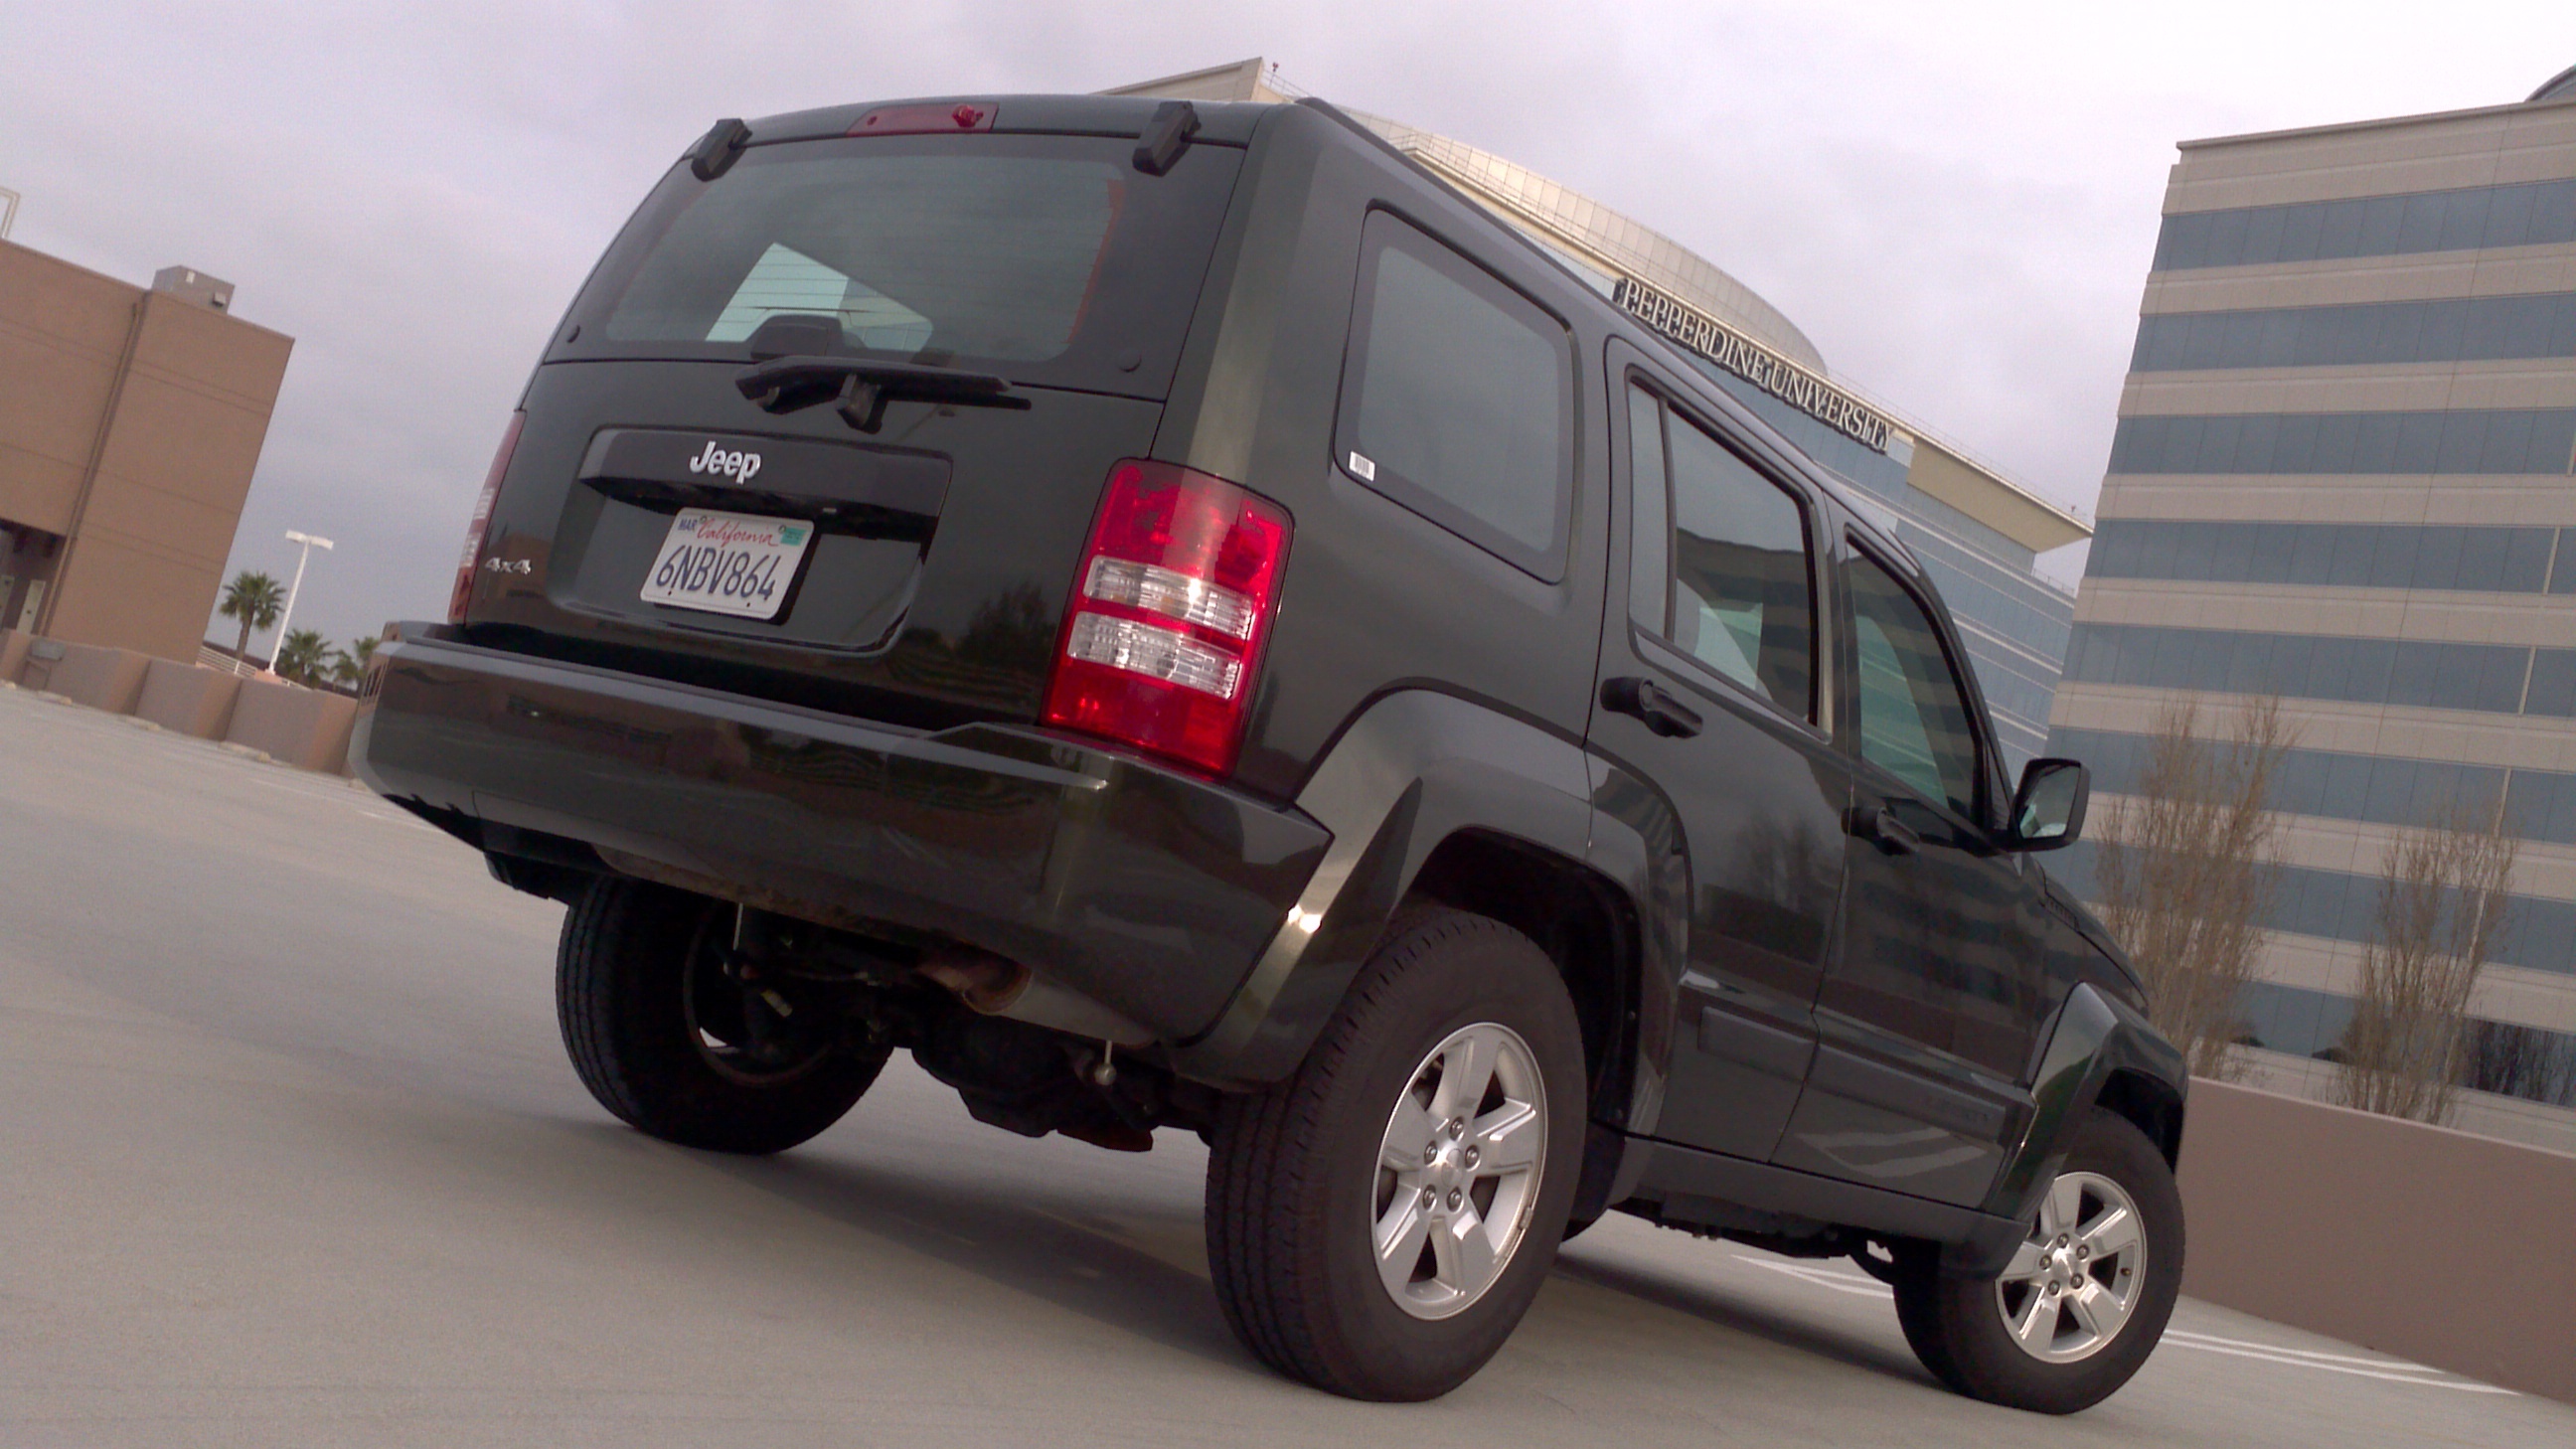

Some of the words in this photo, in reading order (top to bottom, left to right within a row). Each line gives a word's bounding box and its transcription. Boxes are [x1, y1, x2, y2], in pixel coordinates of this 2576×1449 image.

[1622, 277, 1767, 383] PEPPERDINE
[1770, 360, 1894, 450] UNIVERSITY
[690, 440, 762, 485] Jeep
[697, 518, 779, 548] California
[485, 557, 532, 575] 4x4
[656, 545, 781, 601] 6NBV864
